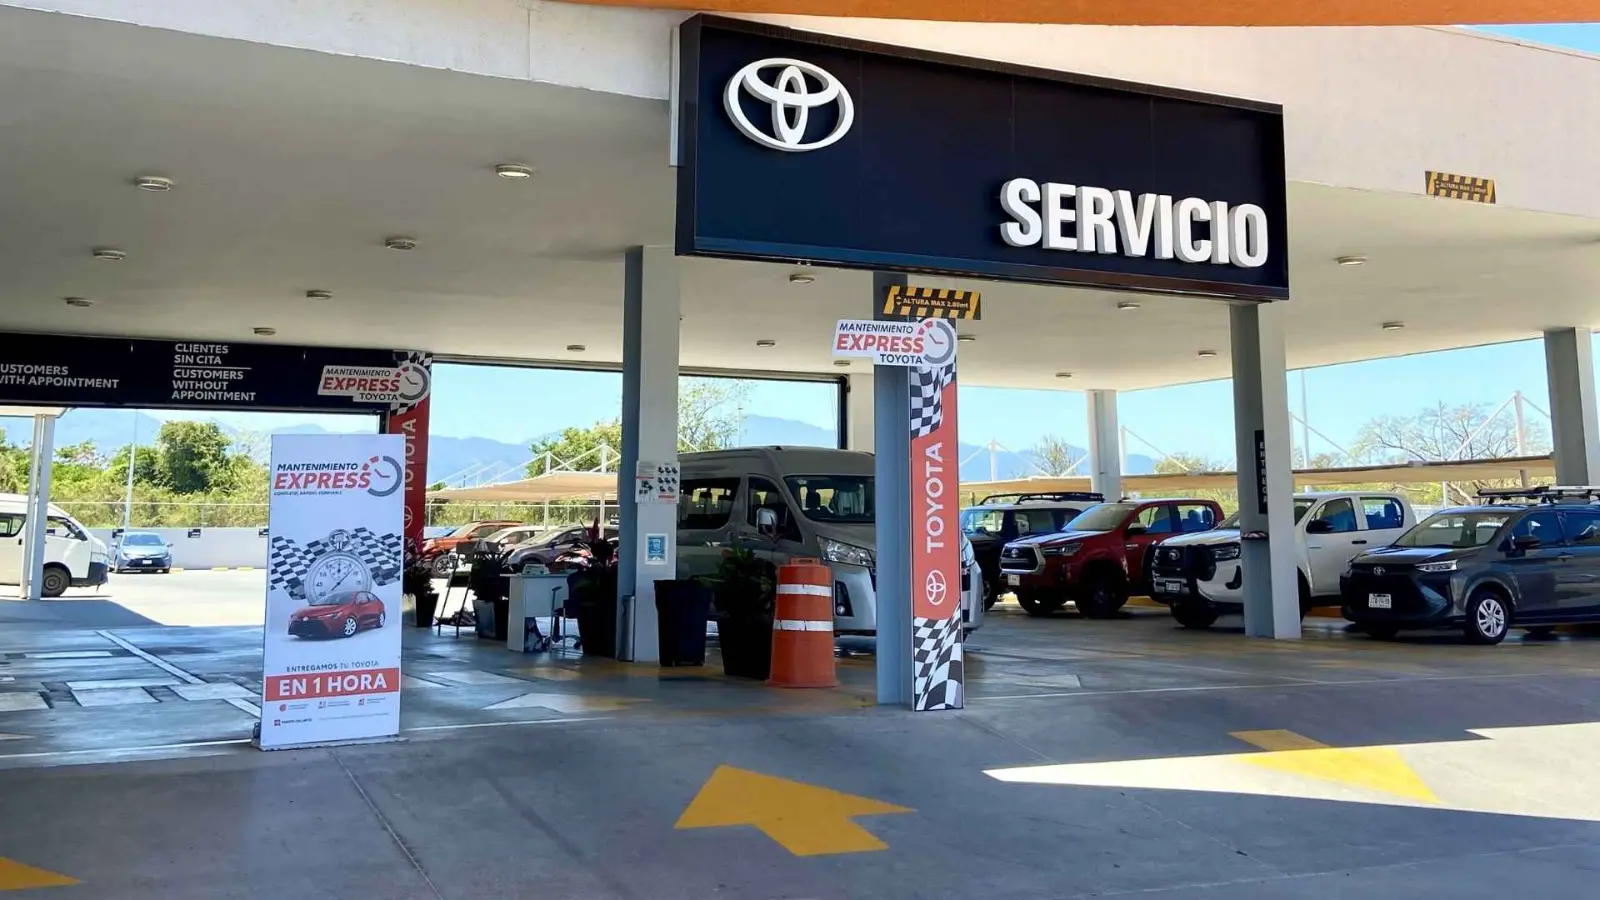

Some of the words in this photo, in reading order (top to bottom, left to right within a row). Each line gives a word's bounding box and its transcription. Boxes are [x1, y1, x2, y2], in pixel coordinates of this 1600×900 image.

[1000, 178, 1268, 268] SERVICIO
[903, 298, 929, 306] ALTURA
[839, 323, 914, 334] MANTENIMIENTO
[175, 343, 229, 354] CLIENTES
[836, 334, 924, 353] EXPRESS
[174, 354, 194, 364] SIN
[196, 355, 222, 365] CITA
[880, 354, 923, 364] TOYOTA
[0, 363, 69, 375] USTOMERS
[173, 369, 244, 380] CUSTOMERS
[325, 368, 391, 377] MANTENIMIENTO
[28, 376, 120, 388] APPOINTMENT
[172, 380, 229, 390] WITHOUT
[323, 377, 400, 392] EXPRESS
[171, 390, 257, 401] APPOINTMENT
[359, 393, 398, 401] TOYOTA
[277, 463, 358, 471] MANTENIMIENTO
[274, 472, 371, 490] EXPRESS
[925, 442, 944, 554] TOYOTA
[286, 663, 338, 672] ENTREGAMOS
[279, 679, 306, 696] EN
[313, 677, 321, 694] 1
[327, 673, 387, 693] HORA
